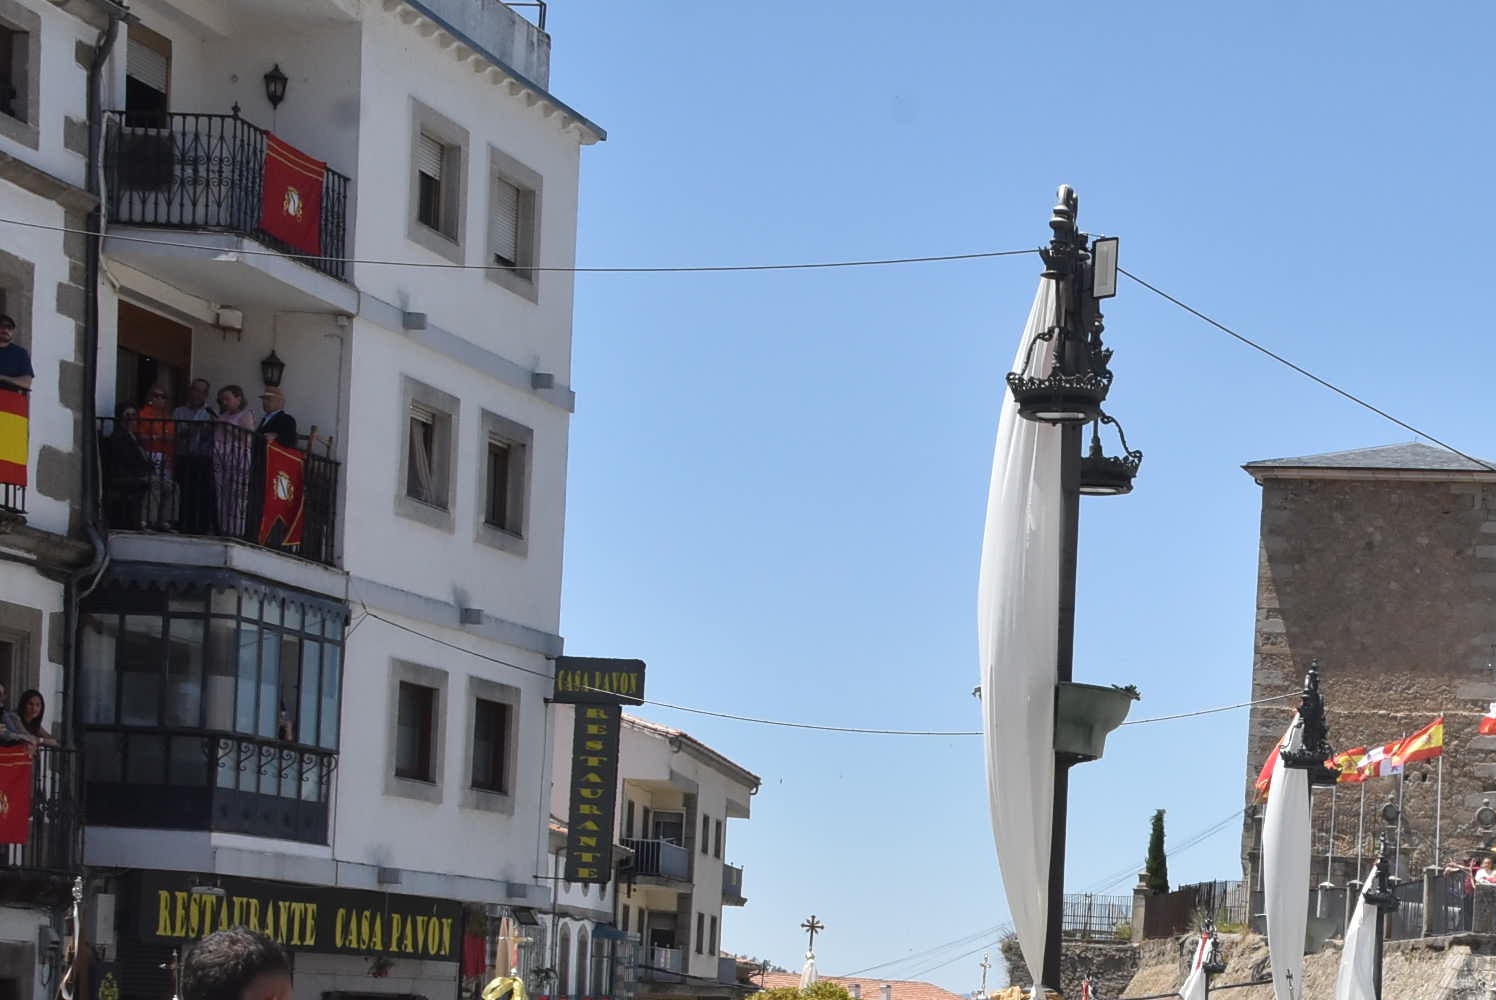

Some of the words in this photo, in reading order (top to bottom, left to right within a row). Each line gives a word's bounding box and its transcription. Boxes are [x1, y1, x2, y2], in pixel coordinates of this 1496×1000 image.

[558, 669, 589, 692] CASA
[574, 708, 608, 879] RESTAURANTE
[156, 890, 317, 946] RESTAURANTE
[335, 907, 384, 950] CASA
[389, 904, 454, 956] PAVÓN
